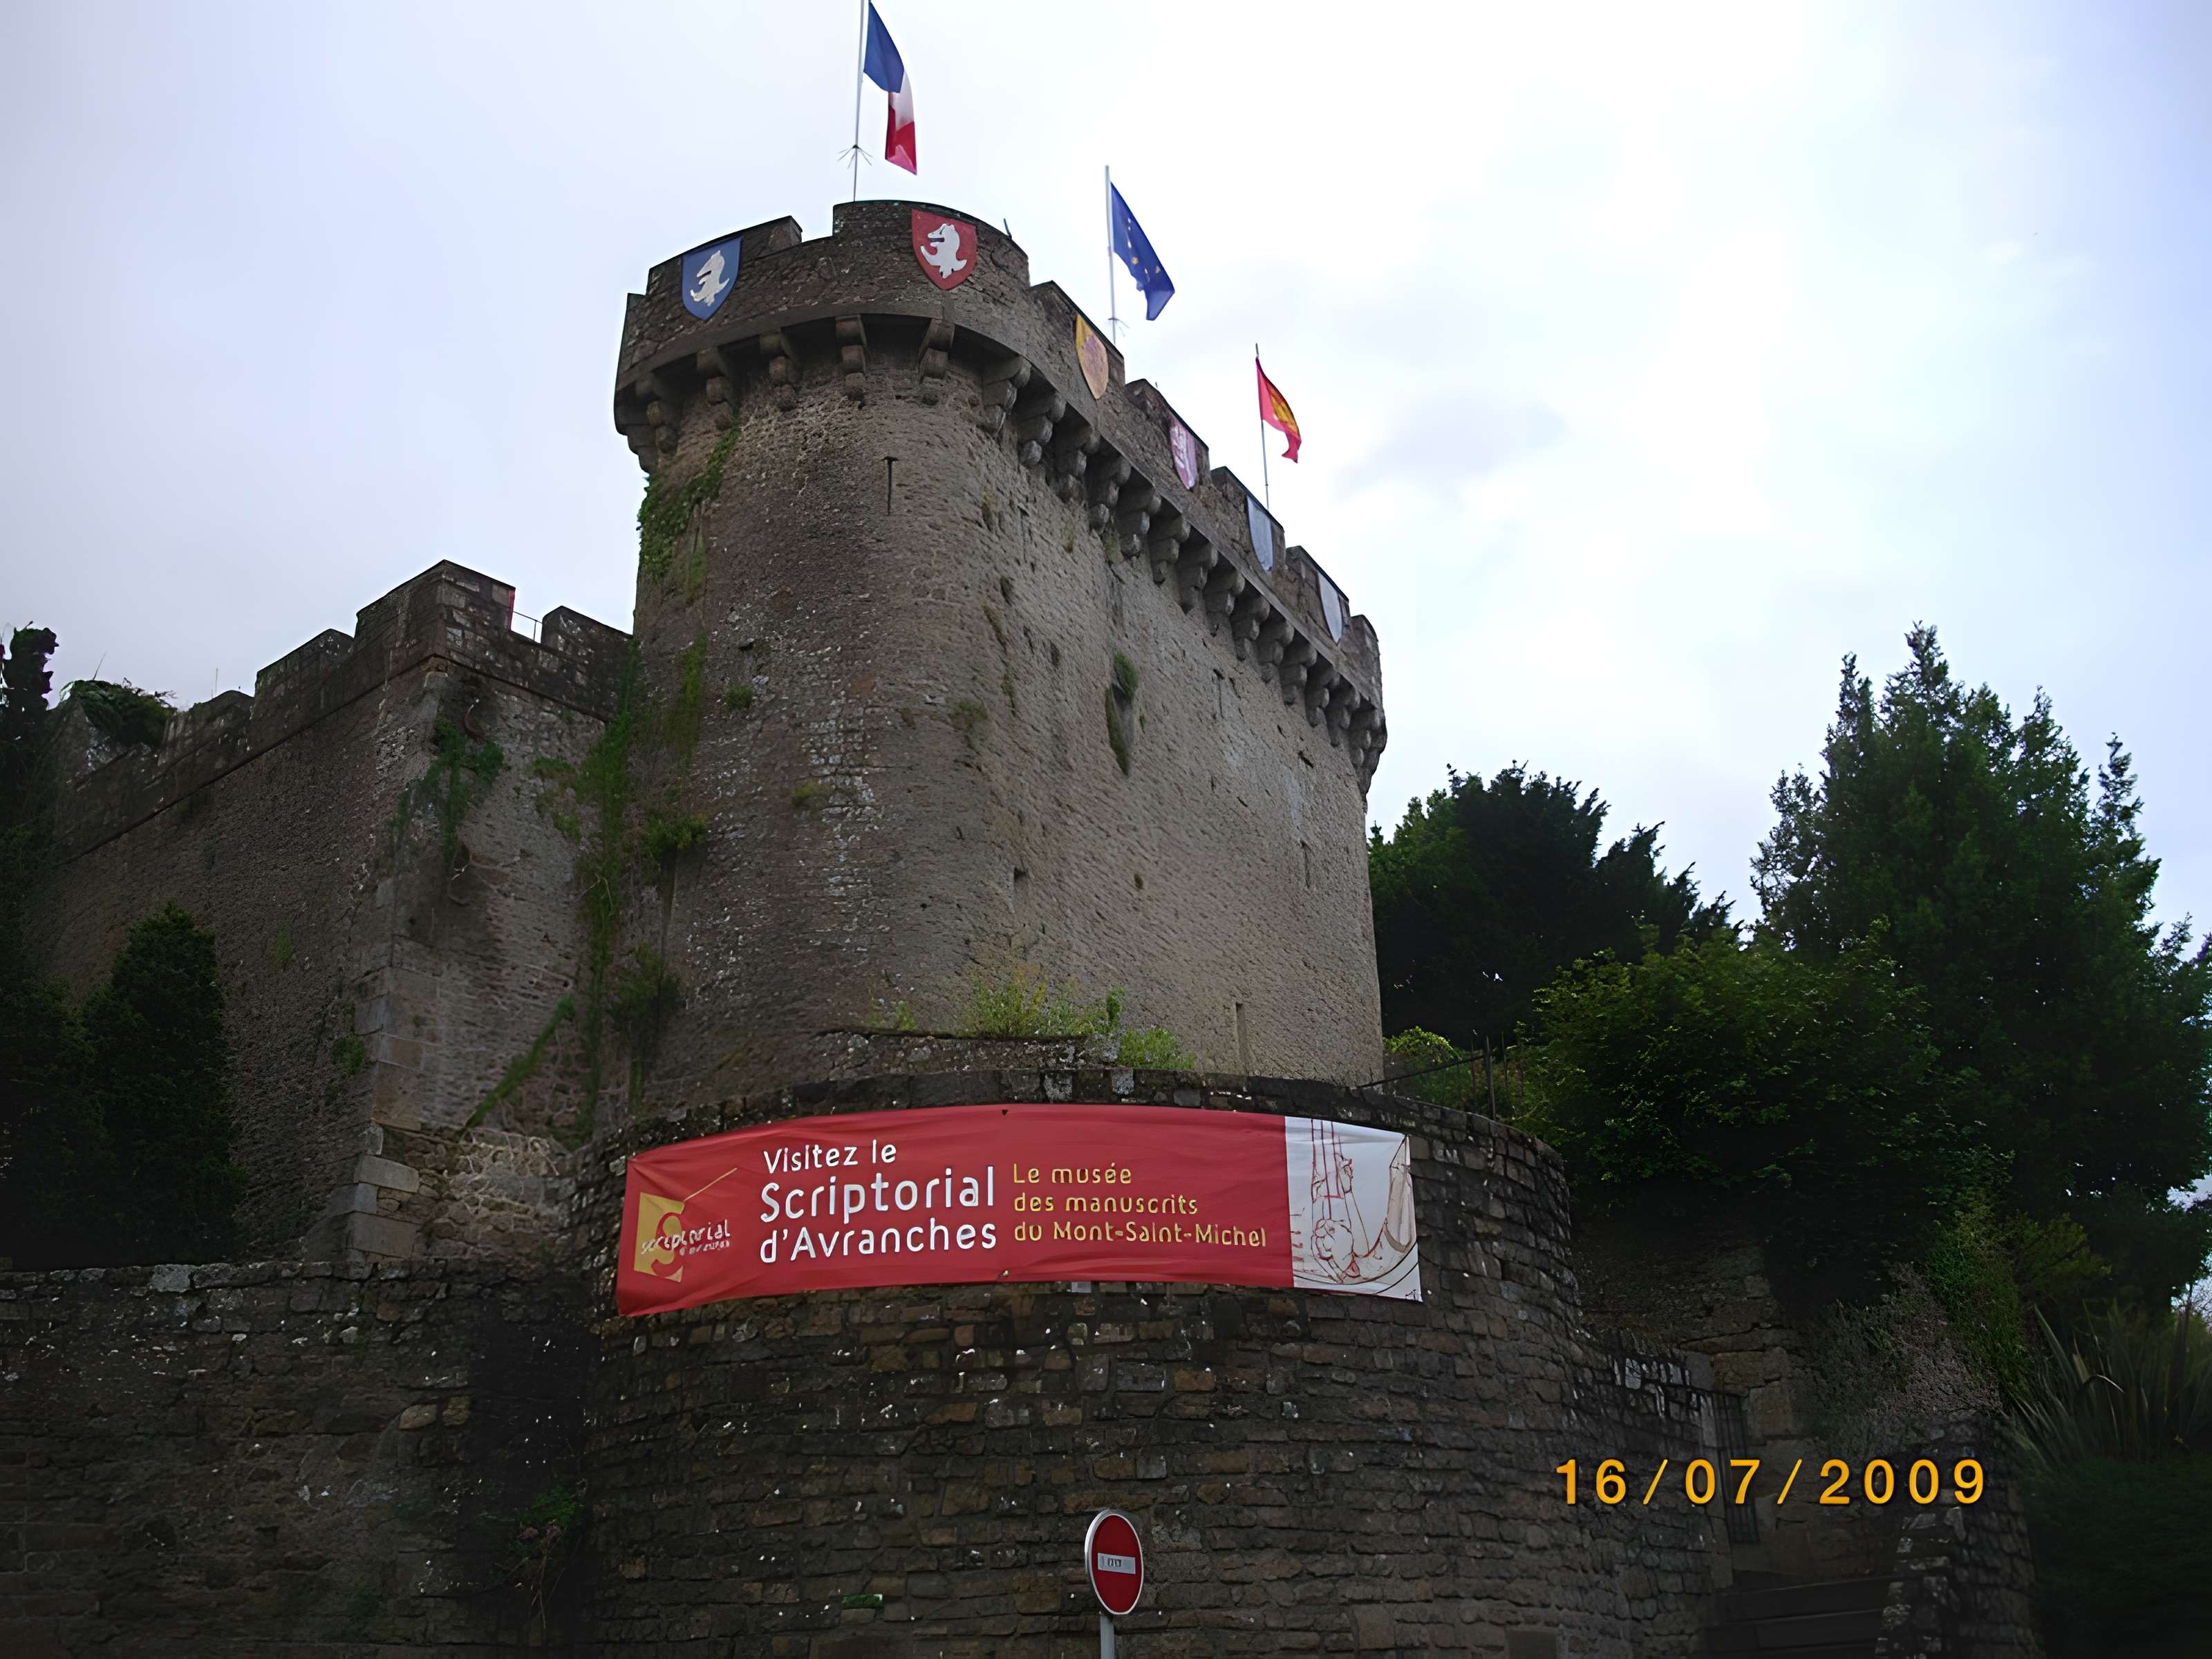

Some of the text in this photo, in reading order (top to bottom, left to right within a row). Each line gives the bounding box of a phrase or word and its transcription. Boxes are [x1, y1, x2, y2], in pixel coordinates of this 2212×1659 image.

[764, 1139, 897, 1174] Visitez le
[1014, 1163, 1132, 1184] Le musée
[761, 1166, 994, 1224] Scriptorial
[1015, 1192, 1198, 1215] des manuscrits
[760, 1217, 996, 1264] d'Avranches
[1015, 1221, 1266, 1247] du Mont-Saint-Michel
